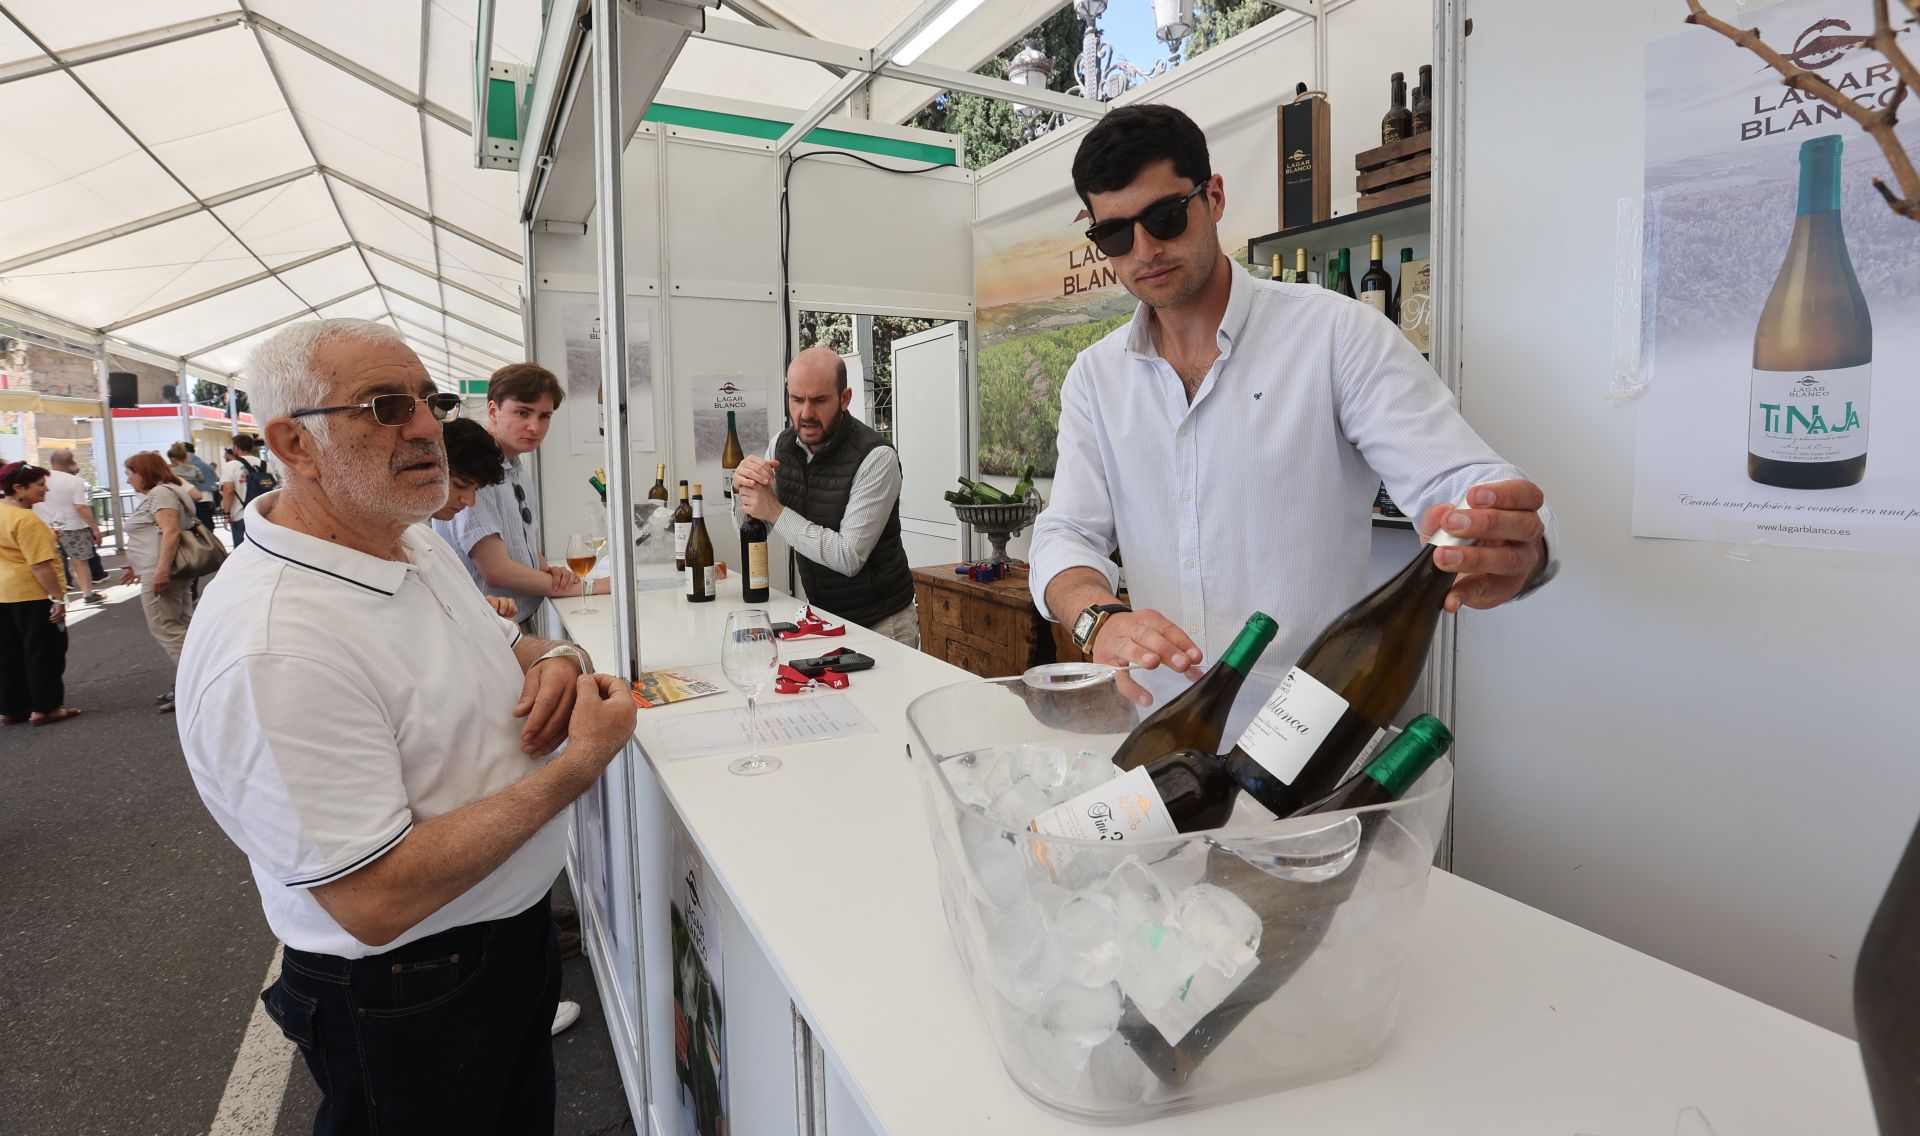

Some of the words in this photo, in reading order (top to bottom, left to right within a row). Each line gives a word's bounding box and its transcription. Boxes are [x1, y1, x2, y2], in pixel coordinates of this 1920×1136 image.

[1285, 165, 1311, 174] BLANCO
[1286, 160, 1310, 169] LAGAR
[1063, 266, 1117, 296] BLAN
[1679, 494, 1720, 506] Cuando
[1860, 507, 1876, 515] en
[1879, 508, 1905, 516] una
[1756, 523, 1851, 536] www.lagarblanco.es
